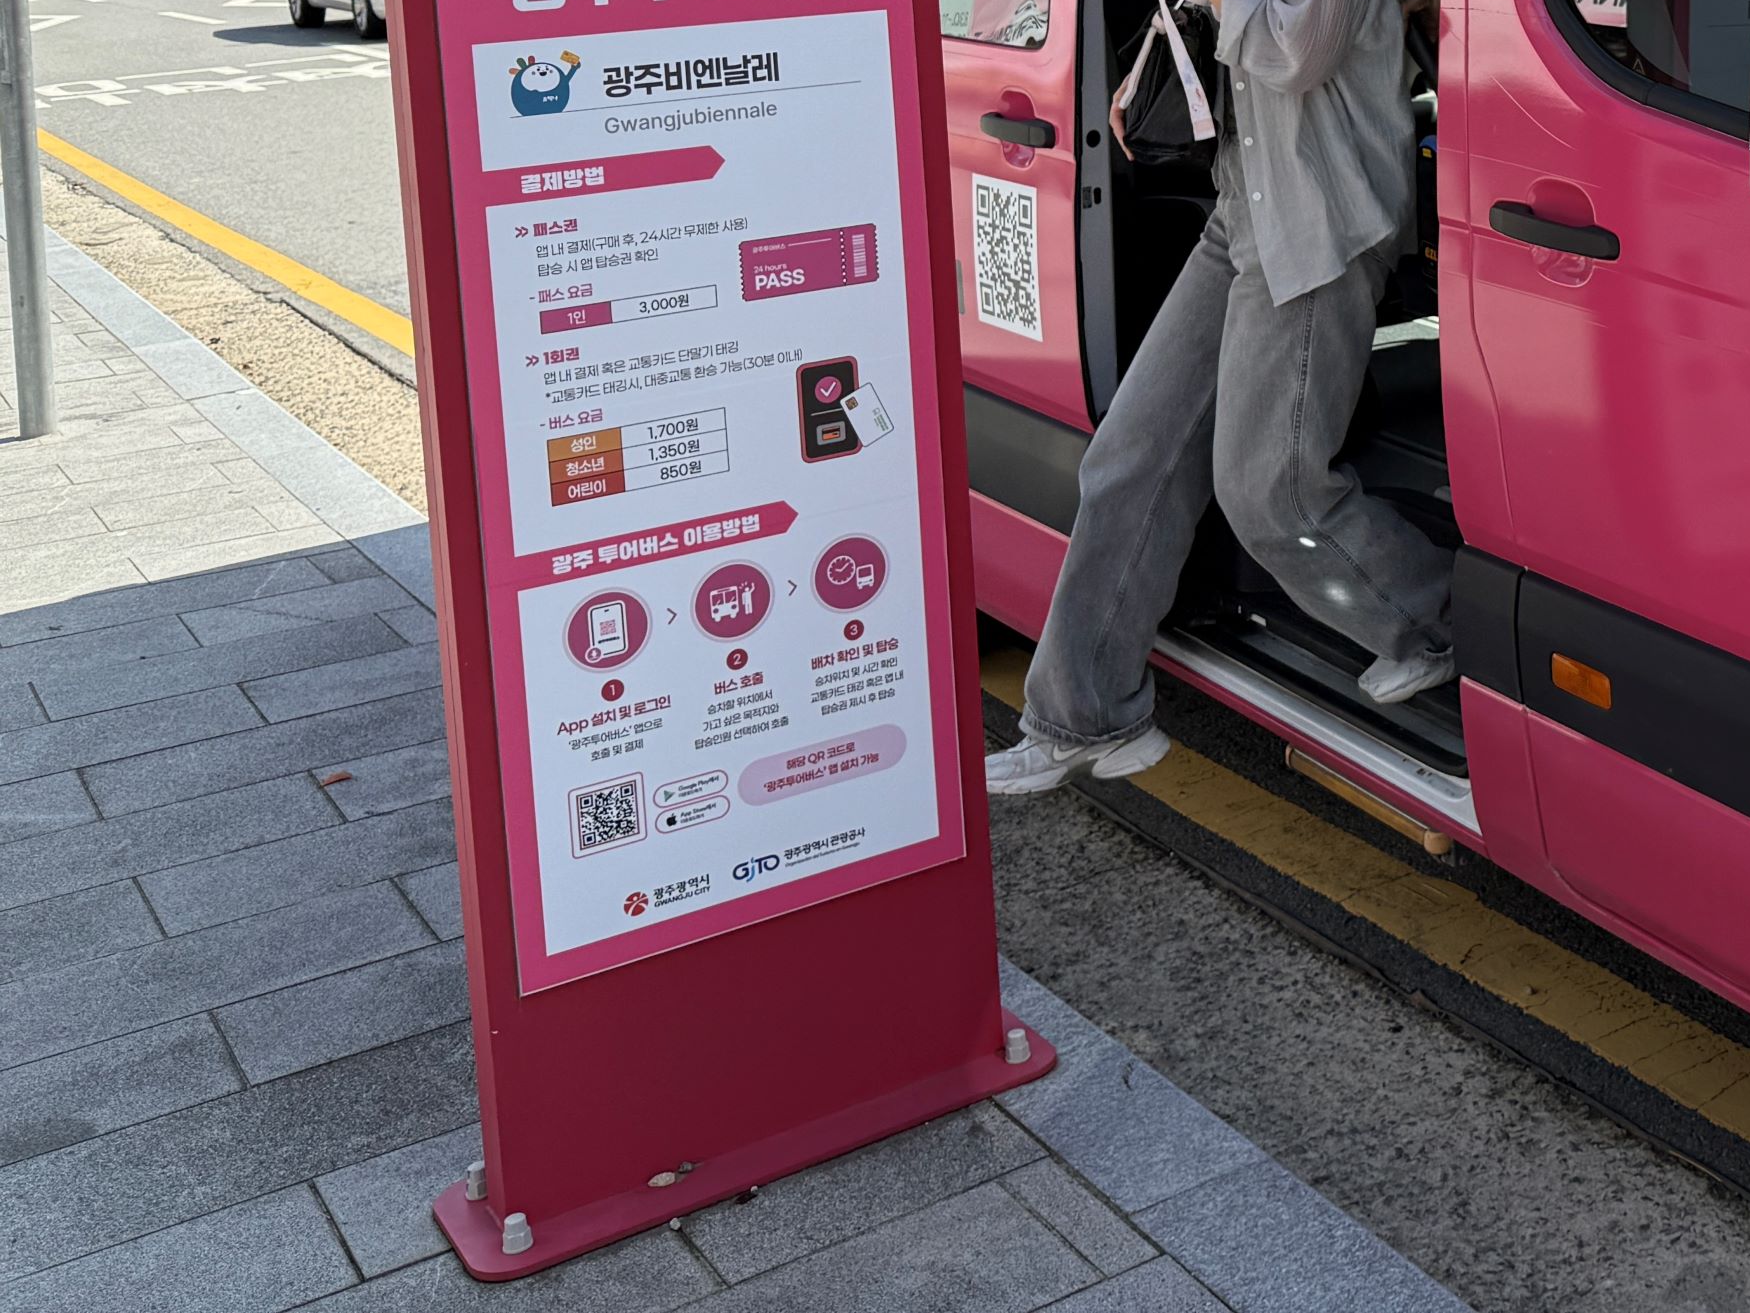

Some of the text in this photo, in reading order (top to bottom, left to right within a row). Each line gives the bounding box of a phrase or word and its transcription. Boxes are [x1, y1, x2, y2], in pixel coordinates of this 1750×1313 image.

[602, 52, 780, 99] 광주비엔날레
[604, 102, 778, 136] Gwangjubiennale
[521, 166, 605, 194] 결제방법
[533, 218, 578, 237] 패스권
[536, 217, 748, 258] 앱 내 결제(구매 후, 24시간 무제한 사용)
[537, 248, 659, 277] 탑승 시 앱 탑승권 확인
[754, 263, 787, 273] 24 hours
[538, 283, 593, 303] 패스 요금
[755, 269, 805, 291] PASS
[567, 294, 690, 325] 1인 3,000원
[543, 347, 580, 365] 1회권
[543, 341, 739, 385] 앱 내 결제 혹은 교통카드 단말기 태깅
[644, 367, 692, 387] 대중교통
[694, 362, 716, 378] 환승
[777, 348, 803, 364] 이내)
[549, 408, 603, 430] 버스 요금
[570, 418, 699, 453] 성인 1,700원
[565, 439, 700, 476] 청소년 1,350원
[567, 460, 702, 499] 어린이 850원
[551, 513, 760, 576] 광주 투어버스 이용방법
[850, 625, 858, 635] 3
[733, 654, 742, 665] 2
[811, 638, 899, 670] 배차 확인 및 탑승
[863, 662, 879, 673] 시간
[714, 672, 764, 695] 버스 호출
[878, 688, 895, 700] 탑승
[737, 689, 773, 707] 위치에서
[557, 695, 671, 736] App 설치 및 로그인
[633, 718, 663, 734] 앱으로
[612, 745, 622, 756] 및
[624, 739, 643, 753] 결제
[787, 742, 856, 770] 해당 QR 코드로
[829, 764, 839, 775] 앱
[784, 839, 829, 860] 광주광역시
[830, 826, 865, 846] 관광공사
[654, 874, 710, 900] 광주광역시
[654, 886, 710, 908] GWANGJU CITY
